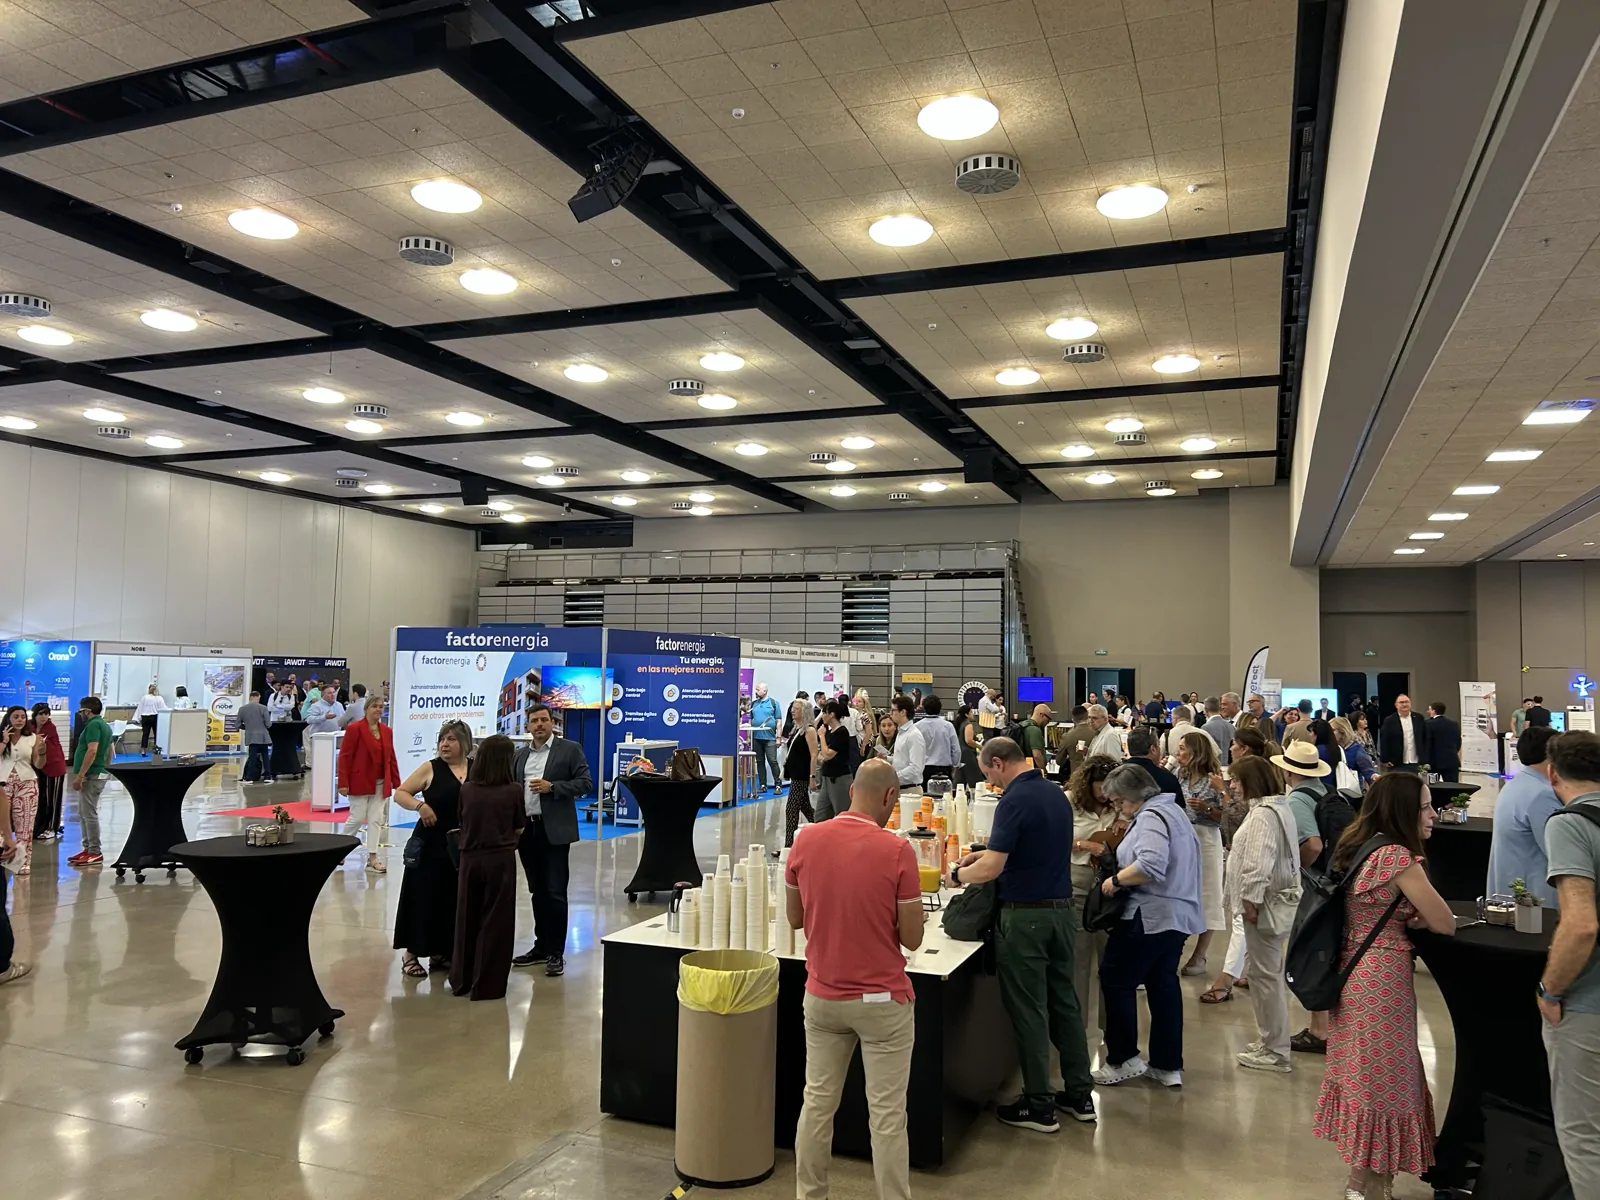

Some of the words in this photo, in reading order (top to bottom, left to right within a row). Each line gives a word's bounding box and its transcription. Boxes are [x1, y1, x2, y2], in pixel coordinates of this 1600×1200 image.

[446, 632, 549, 650] factorenergia
[656, 636, 706, 655] factorenergia
[48, 652, 70, 661] Orona
[422, 655, 471, 667] factorenergia
[679, 656, 690, 664] Tu
[648, 665, 661, 673] las
[662, 665, 695, 675] mejores
[696, 666, 725, 674] manos
[409, 694, 467, 709] Ponemos
[469, 692, 485, 707] luz
[409, 712, 429, 721] donde
[429, 711, 445, 720] otros
[456, 710, 485, 721] problemas
